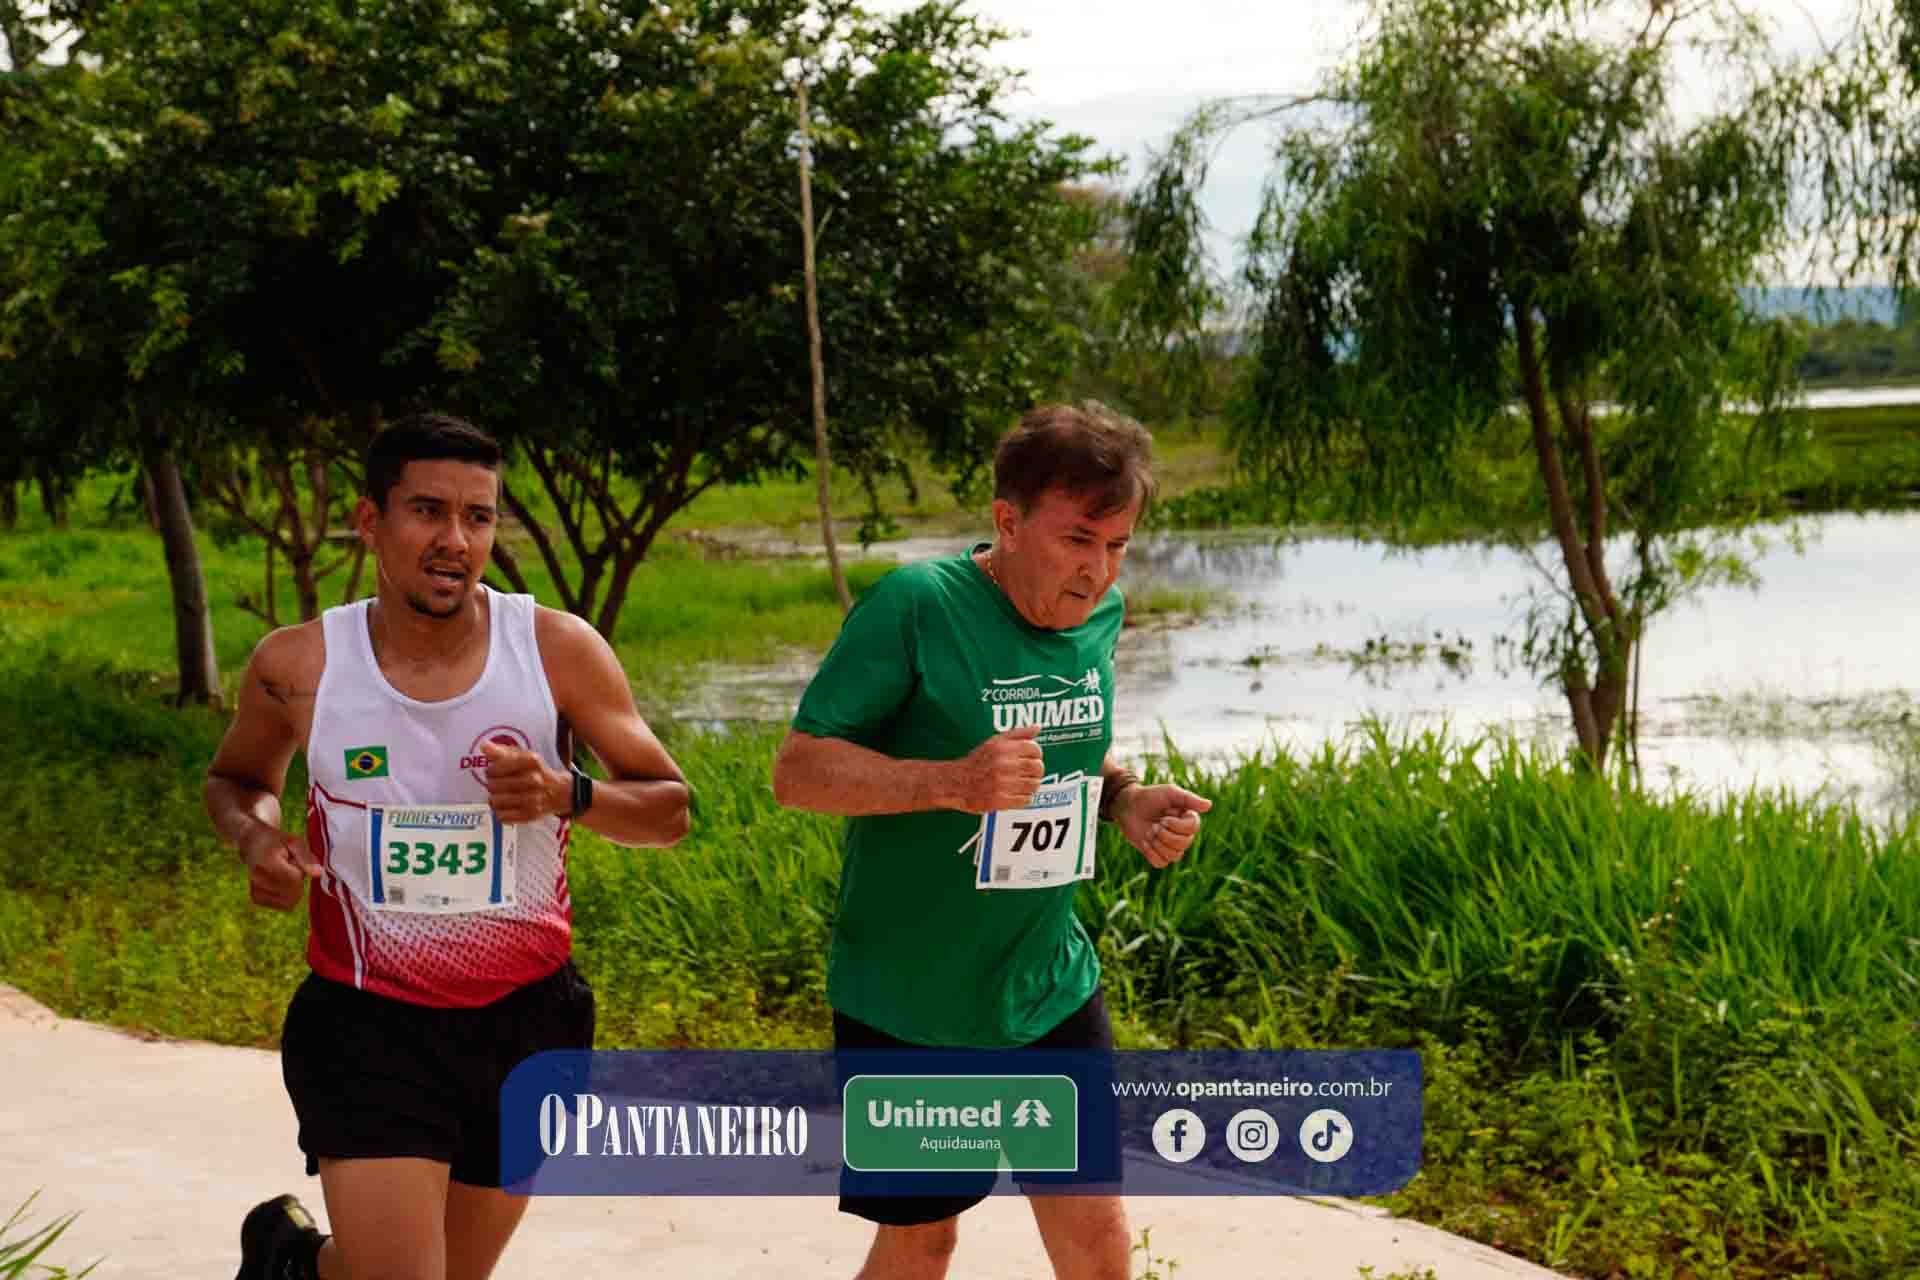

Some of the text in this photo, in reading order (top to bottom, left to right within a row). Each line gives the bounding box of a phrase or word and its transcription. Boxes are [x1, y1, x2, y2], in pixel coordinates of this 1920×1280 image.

[992, 688, 1040, 702] CORRIDA
[992, 695, 1105, 732] UNIMED
[1010, 817, 1070, 852] 707
[386, 841, 487, 876] 3343
